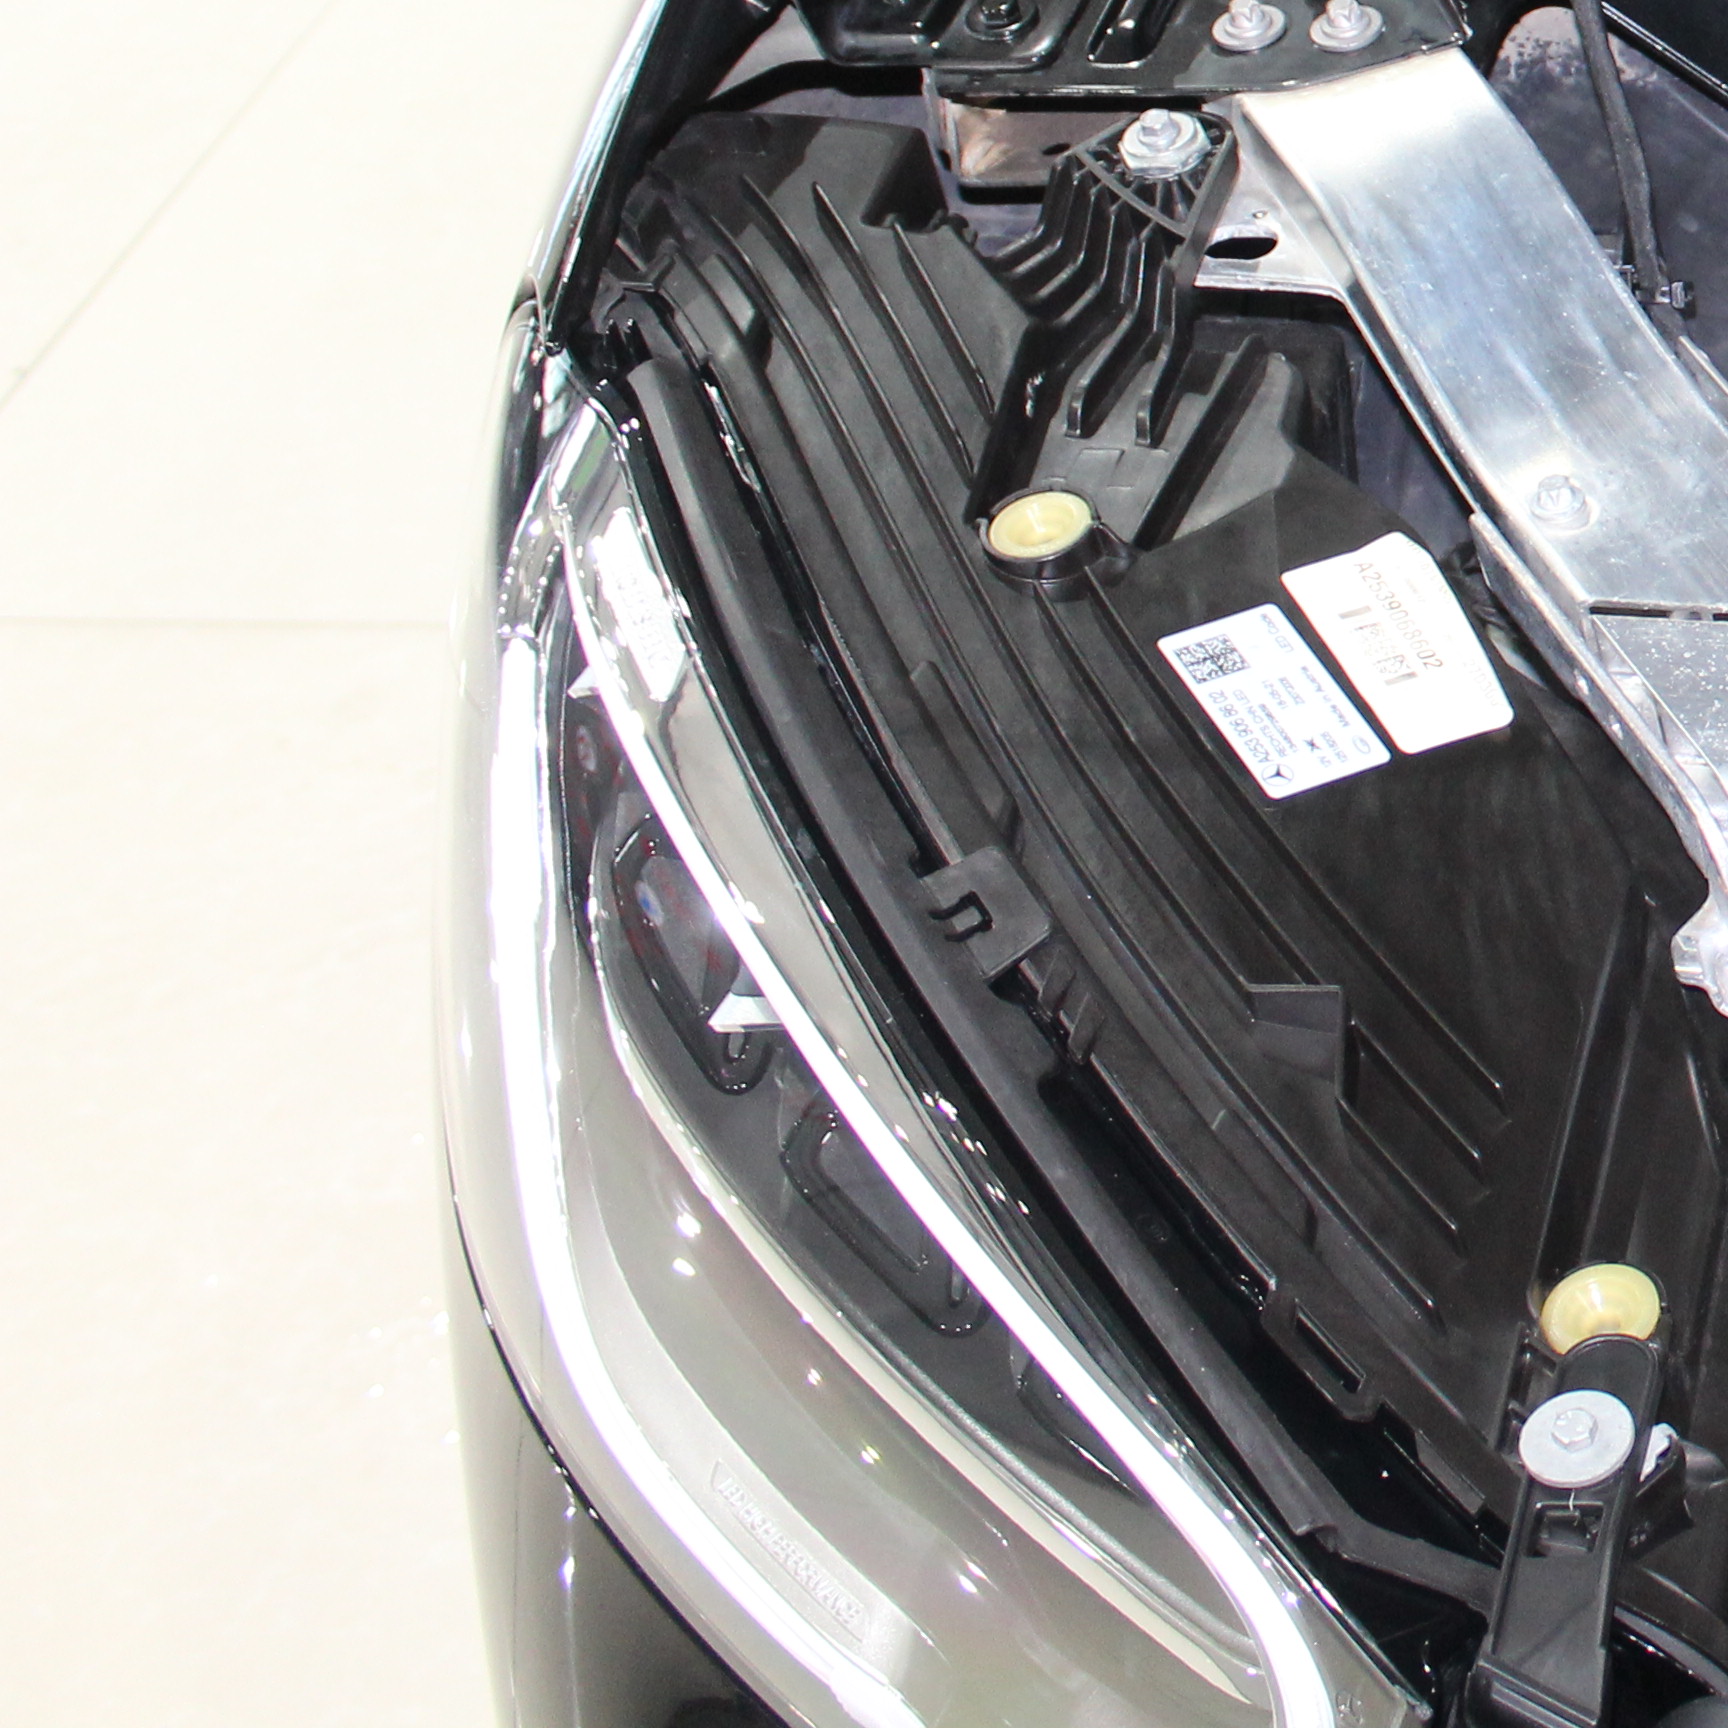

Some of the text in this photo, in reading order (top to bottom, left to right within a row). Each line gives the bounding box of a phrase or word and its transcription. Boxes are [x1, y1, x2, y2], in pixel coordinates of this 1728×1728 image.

[1352, 560, 1445, 670] A2539068602
[1257, 611, 1294, 653] LED Code
[1298, 664, 1325, 693] Austria
[1207, 688, 1228, 703] 02
[1231, 688, 1251, 705] LED
[1228, 717, 1254, 737] 906
[1327, 703, 1351, 727] Made
[1242, 736, 1273, 763] A253
[1257, 724, 1288, 758] RECHTS
